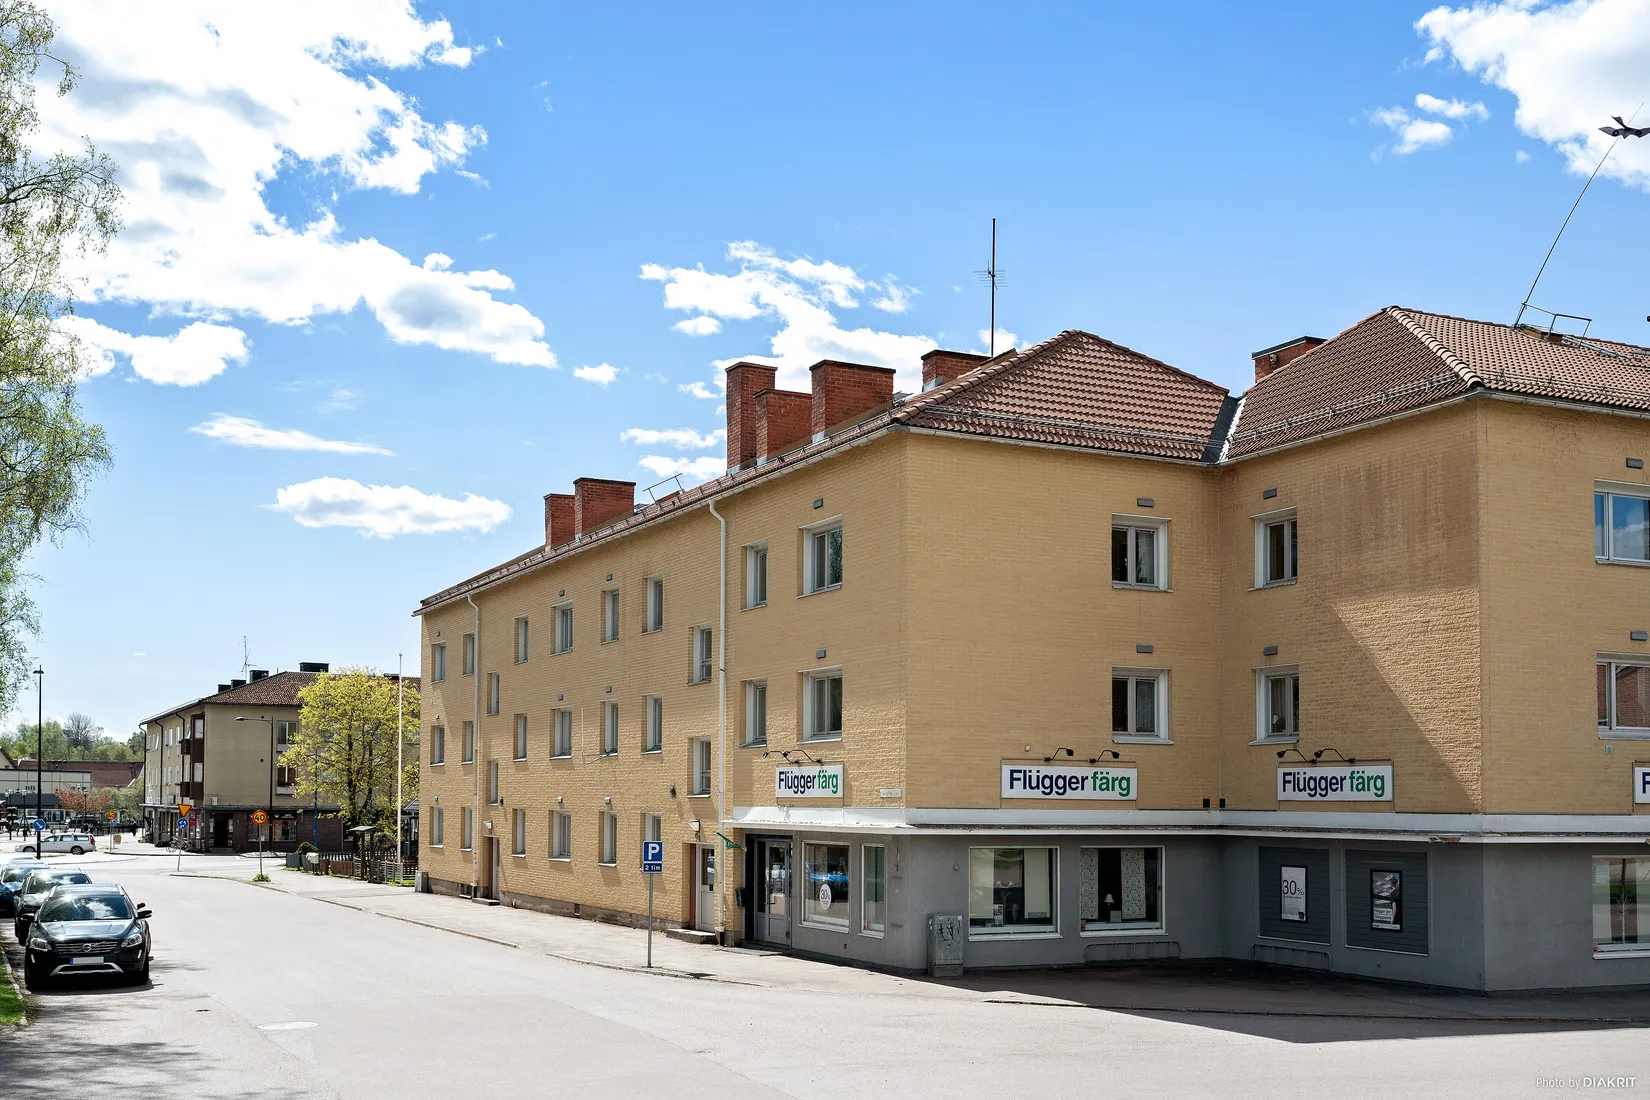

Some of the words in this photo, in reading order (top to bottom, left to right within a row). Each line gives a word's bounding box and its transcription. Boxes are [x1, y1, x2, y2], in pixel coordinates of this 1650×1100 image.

[778, 770, 817, 795] Flügger
[817, 769, 839, 794] färg
[1009, 769, 1089, 796] Flügger
[1091, 770, 1131, 797] färg
[1282, 771, 1347, 798] Flügger
[1349, 770, 1385, 797] färg
[254, 813, 266, 822] 40
[648, 843, 660, 860] P
[1282, 879, 1305, 896] 30%
